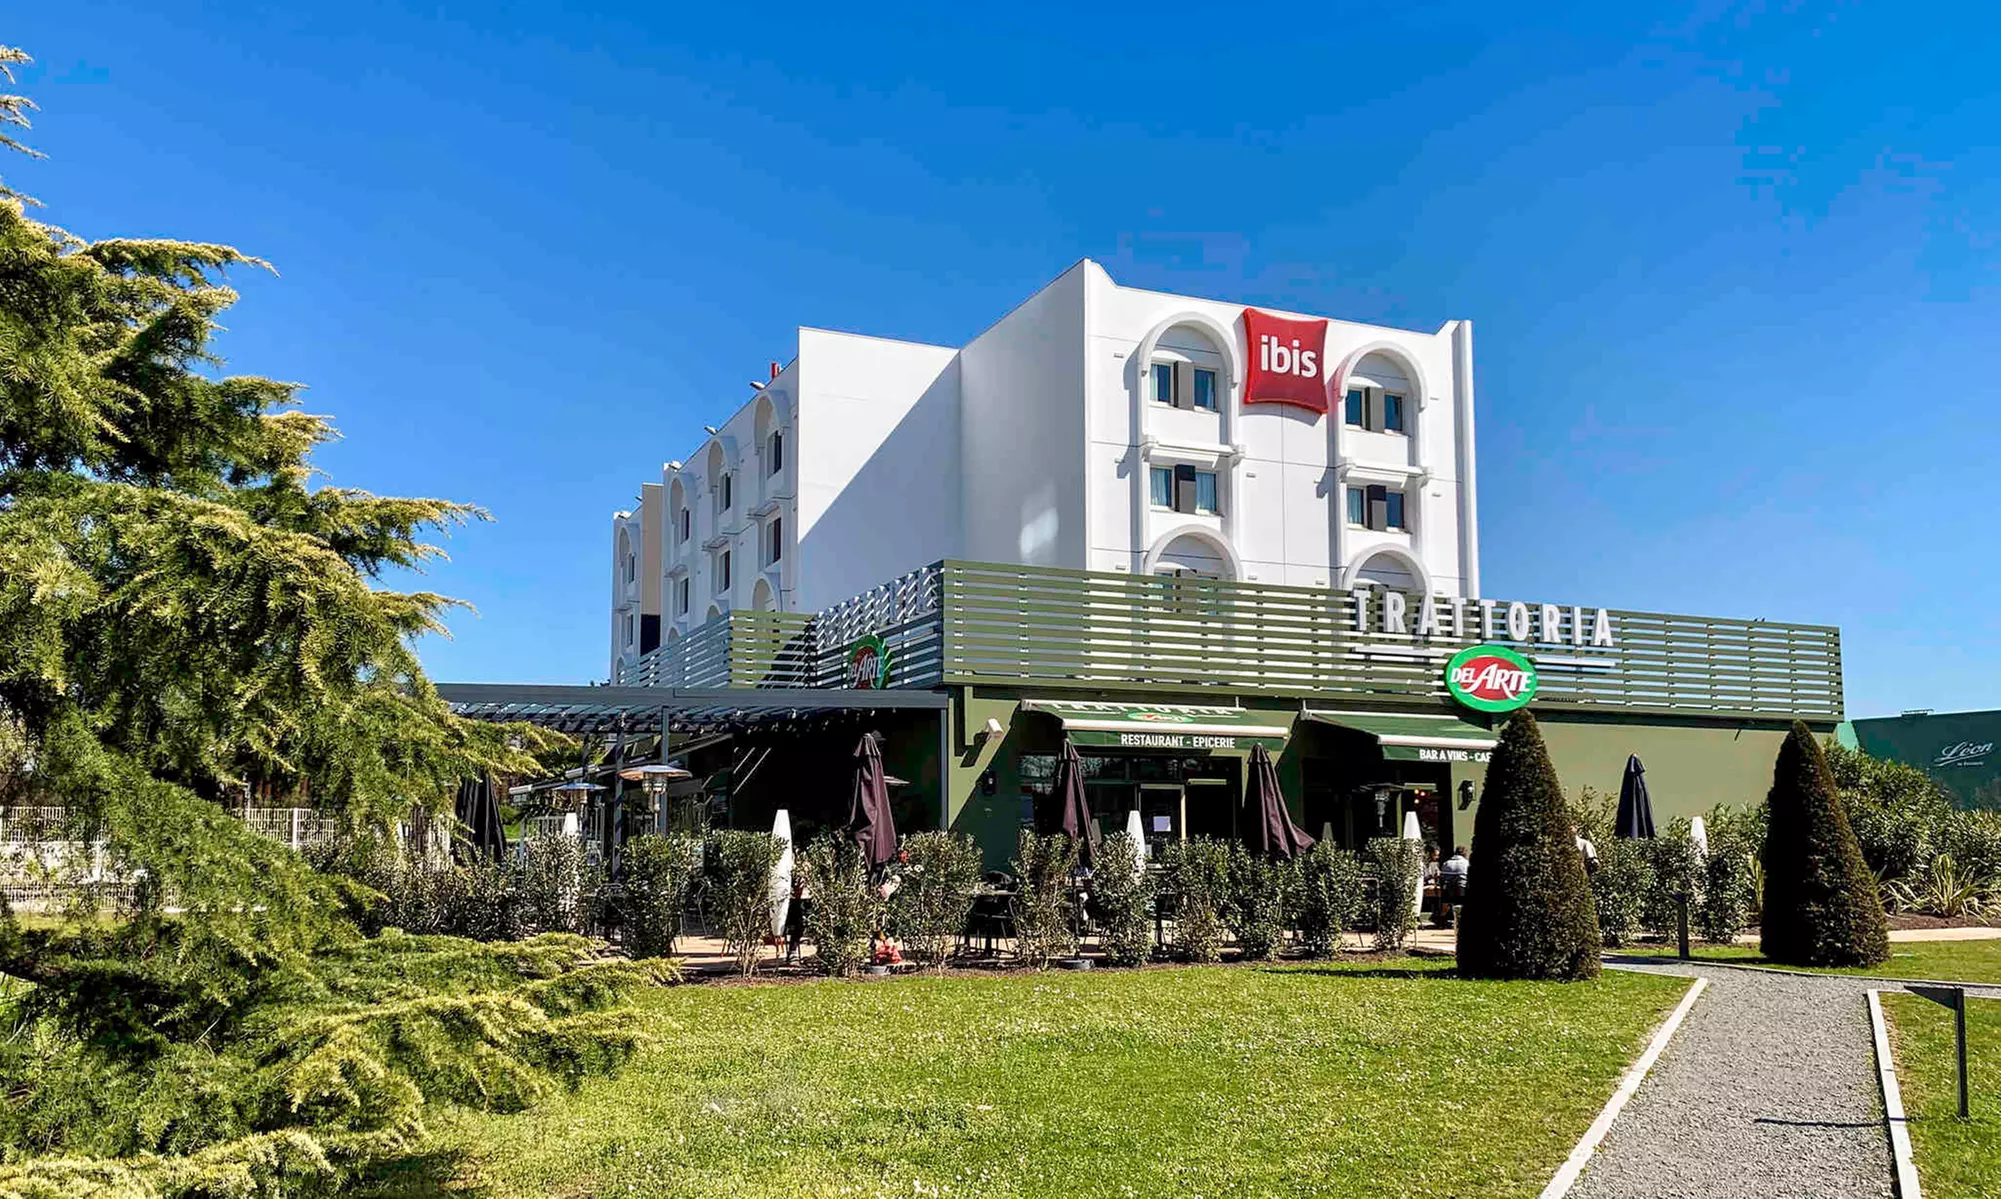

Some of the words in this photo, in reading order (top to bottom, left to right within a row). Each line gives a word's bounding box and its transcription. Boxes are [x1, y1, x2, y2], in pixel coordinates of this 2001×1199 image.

[1261, 334, 1317, 378] ibis
[1353, 589, 1614, 647] TRATTORIA
[1450, 667, 1476, 684] DEL
[1458, 663, 1533, 702] ARTE
[1121, 734, 1184, 746] RESTAURANT
[1193, 737, 1235, 748] EPICERIE
[1420, 749, 1438, 760] BAR
[1440, 750, 1446, 760] A
[1447, 750, 1468, 761] VINS
[1475, 752, 1493, 762] CAF
